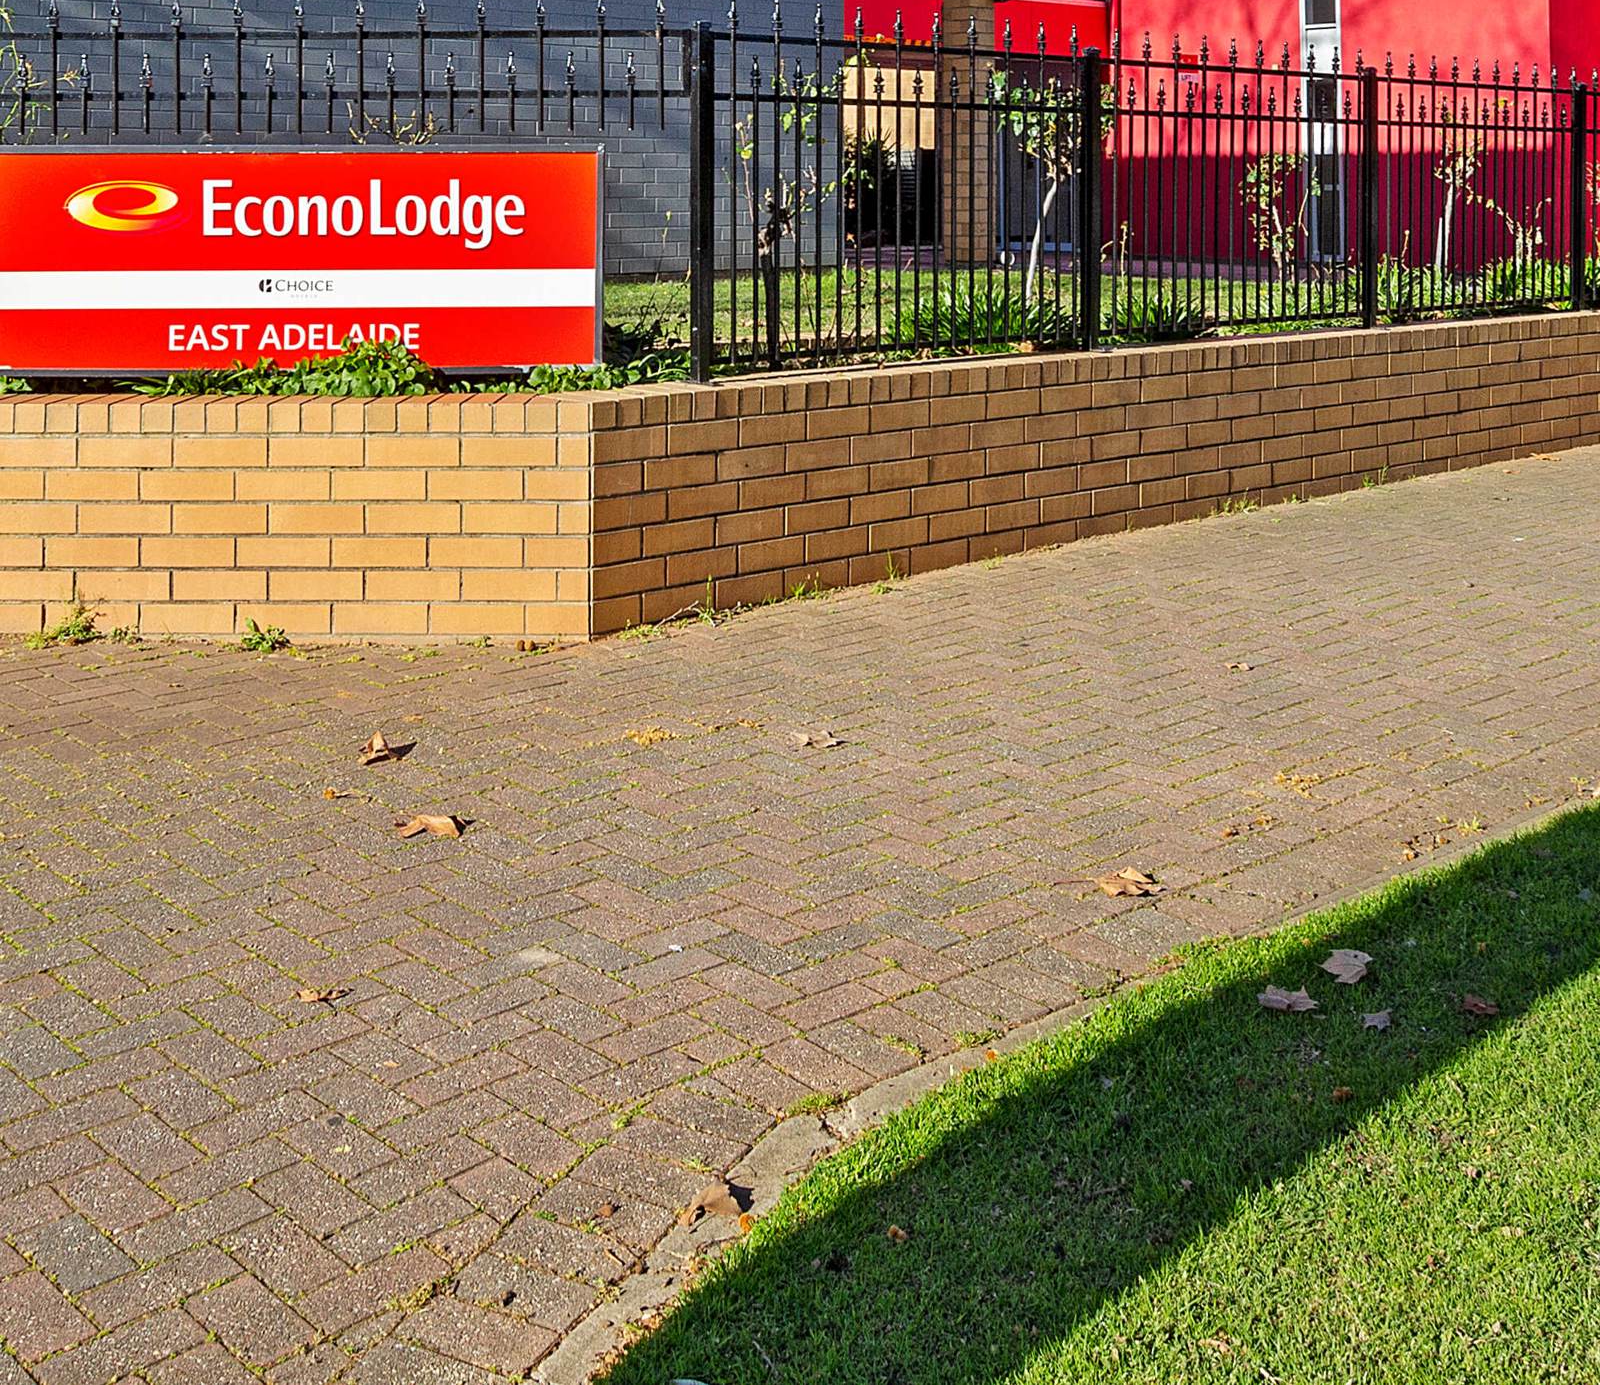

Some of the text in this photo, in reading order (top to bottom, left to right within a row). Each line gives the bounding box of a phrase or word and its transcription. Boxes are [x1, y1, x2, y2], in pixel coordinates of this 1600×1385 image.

[202, 178, 526, 250] EconoLodge
[275, 279, 334, 292] CHOICE
[168, 323, 420, 352] EAST ADELAIDE
